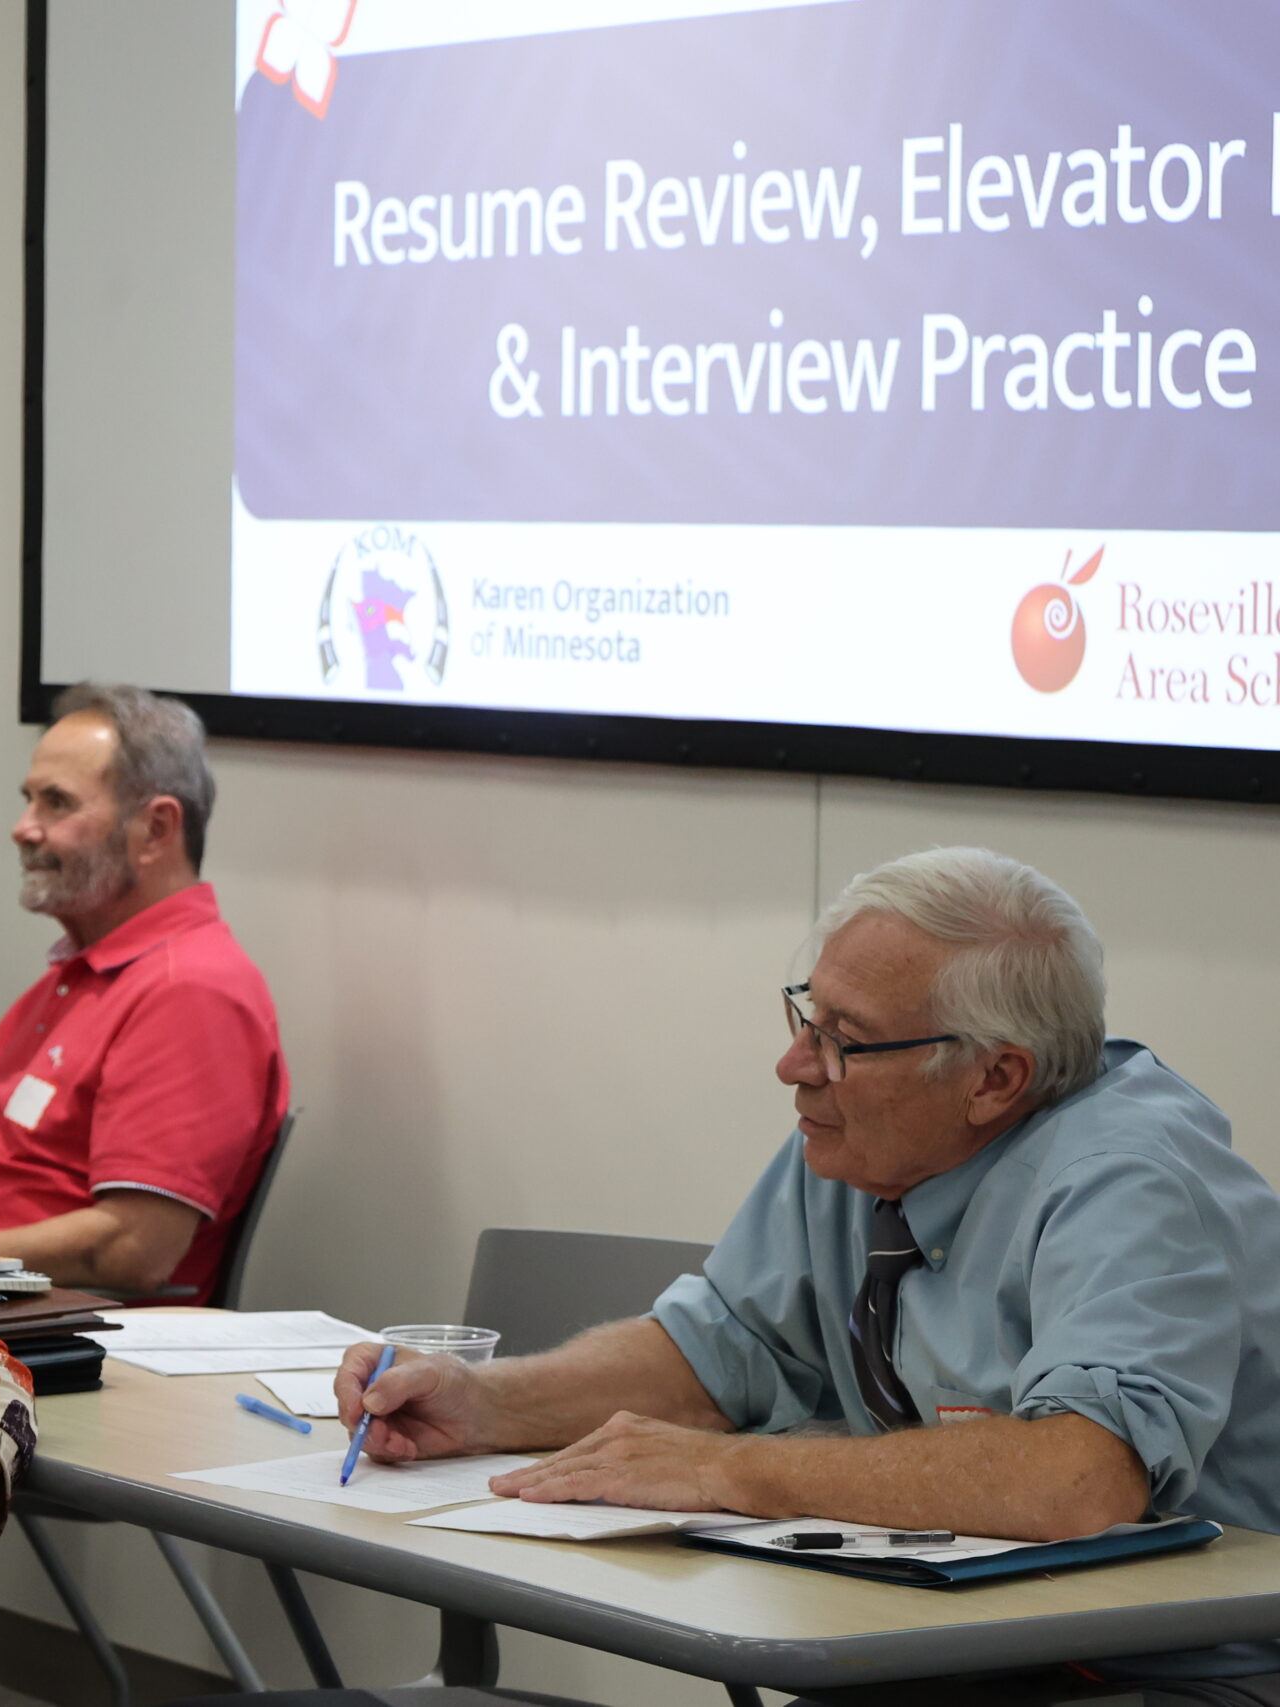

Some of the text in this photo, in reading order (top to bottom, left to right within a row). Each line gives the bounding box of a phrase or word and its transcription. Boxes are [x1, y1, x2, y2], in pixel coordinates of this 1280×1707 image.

[333, 180, 586, 267] Resume
[605, 140, 878, 259] Review,
[901, 122, 1247, 235] Elevator
[488, 295, 1257, 419] & Interview Practice
[353, 525, 417, 559] KOM
[472, 577, 731, 624] Karen Organization
[1116, 578, 1280, 637] Rosevill
[470, 620, 642, 664] of Minnesota
[1115, 651, 1211, 704] Area
